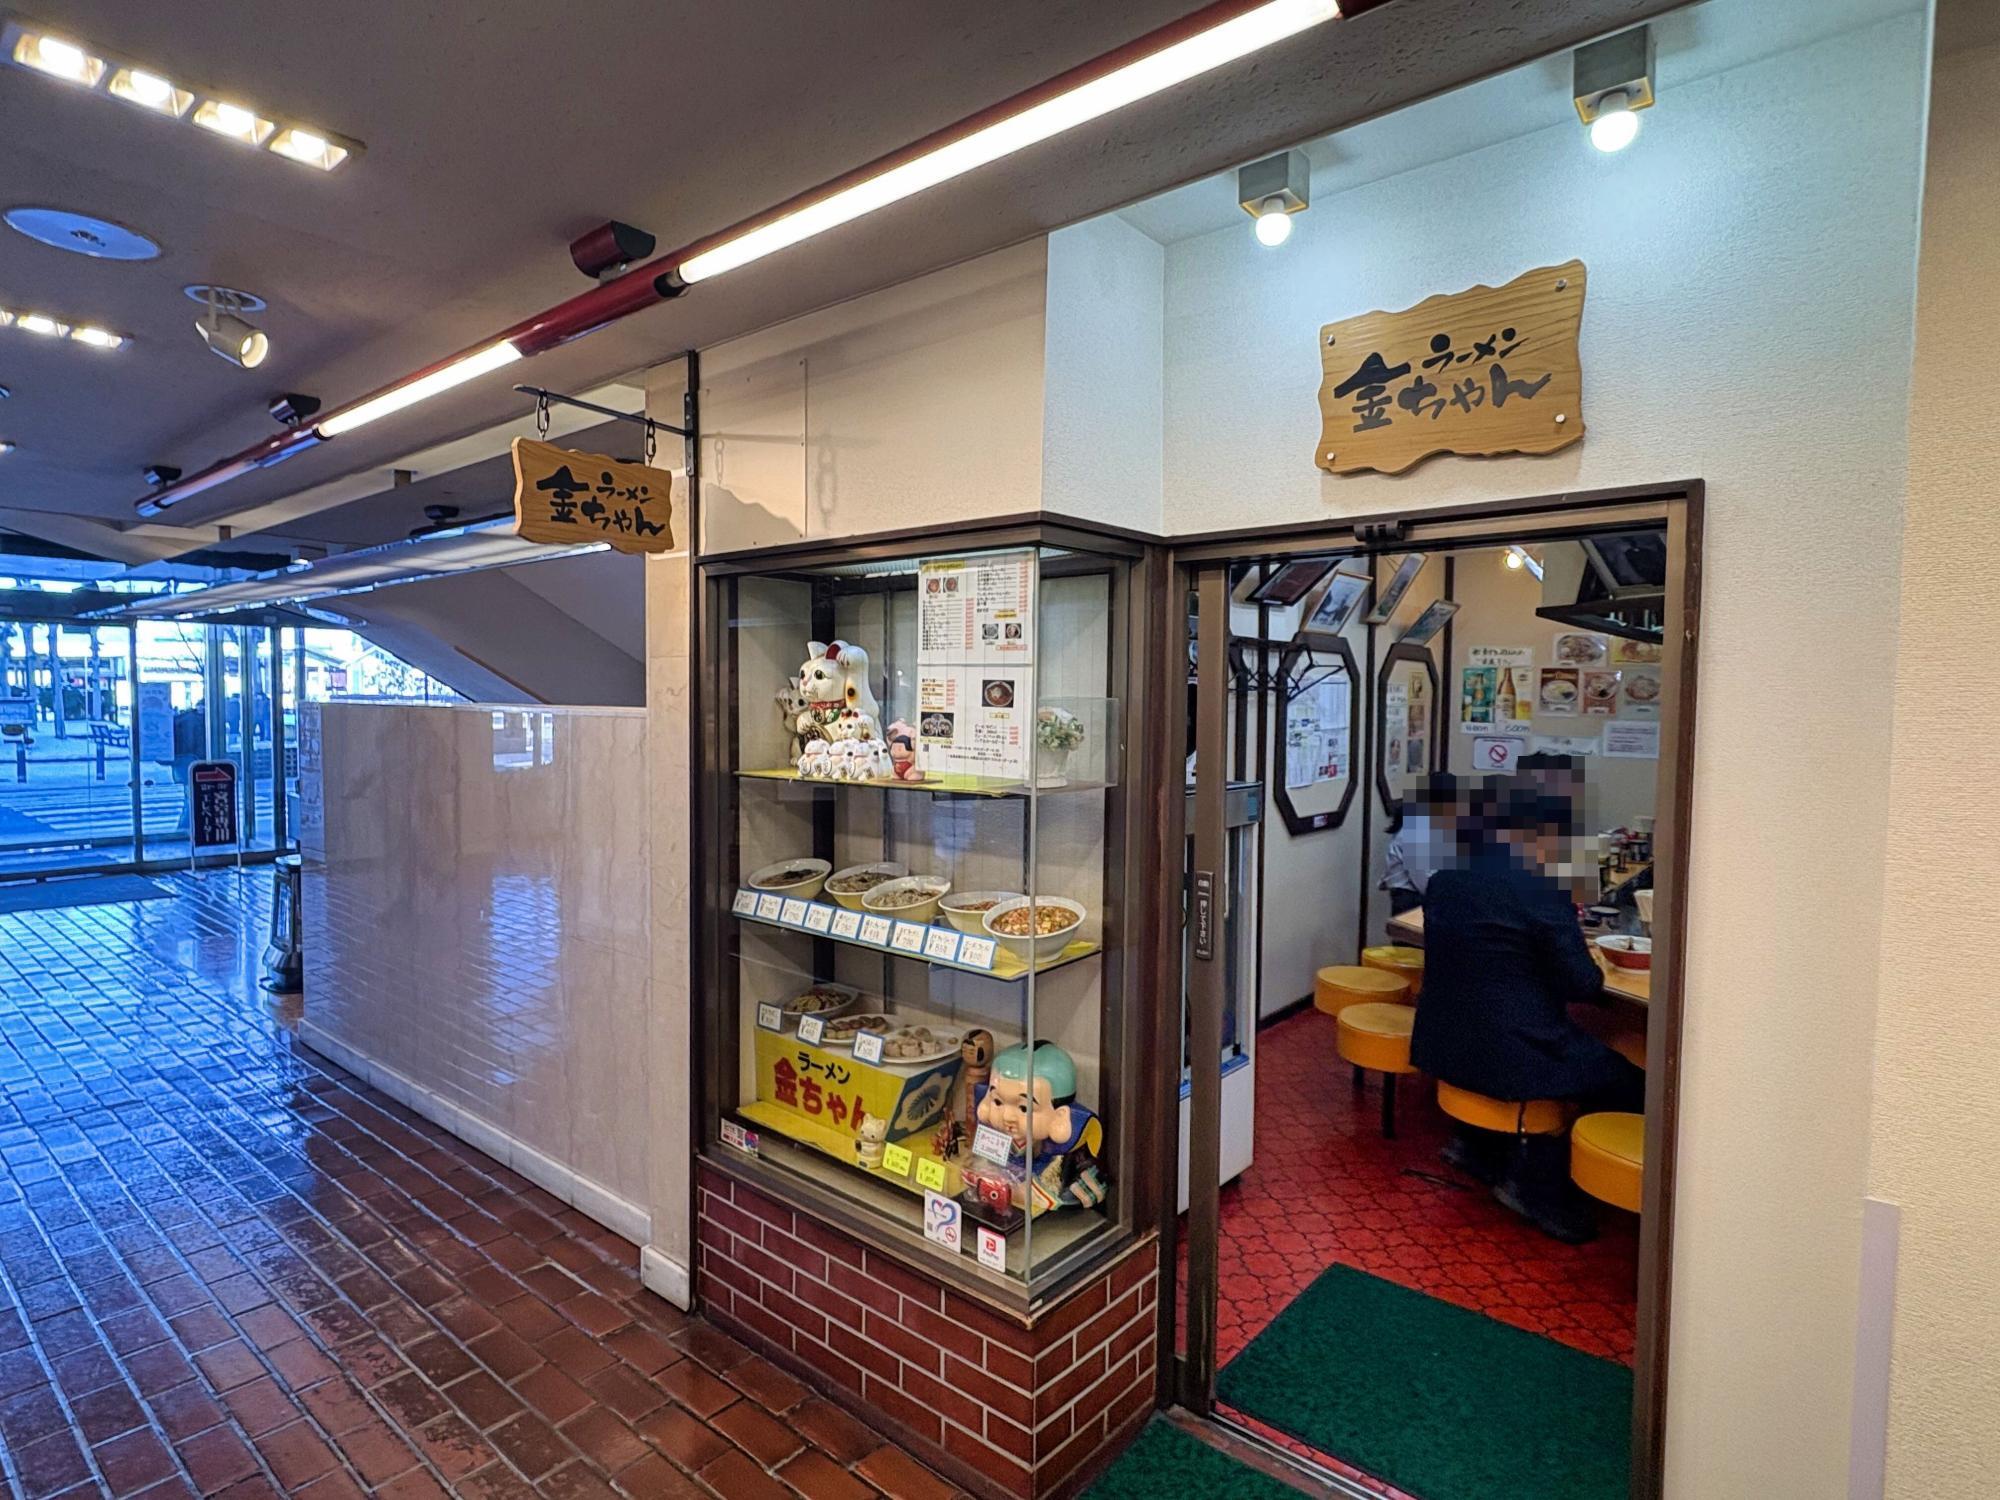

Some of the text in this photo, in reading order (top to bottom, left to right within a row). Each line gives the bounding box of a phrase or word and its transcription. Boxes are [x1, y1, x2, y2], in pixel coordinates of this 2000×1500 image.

[1422, 327, 1530, 374] ラーメン
[1333, 352, 1553, 433] 金ちゃん
[536, 465, 666, 536] 金ちゃん
[597, 471, 656, 504] ラーメン
[798, 1051, 851, 1084] ラーメン
